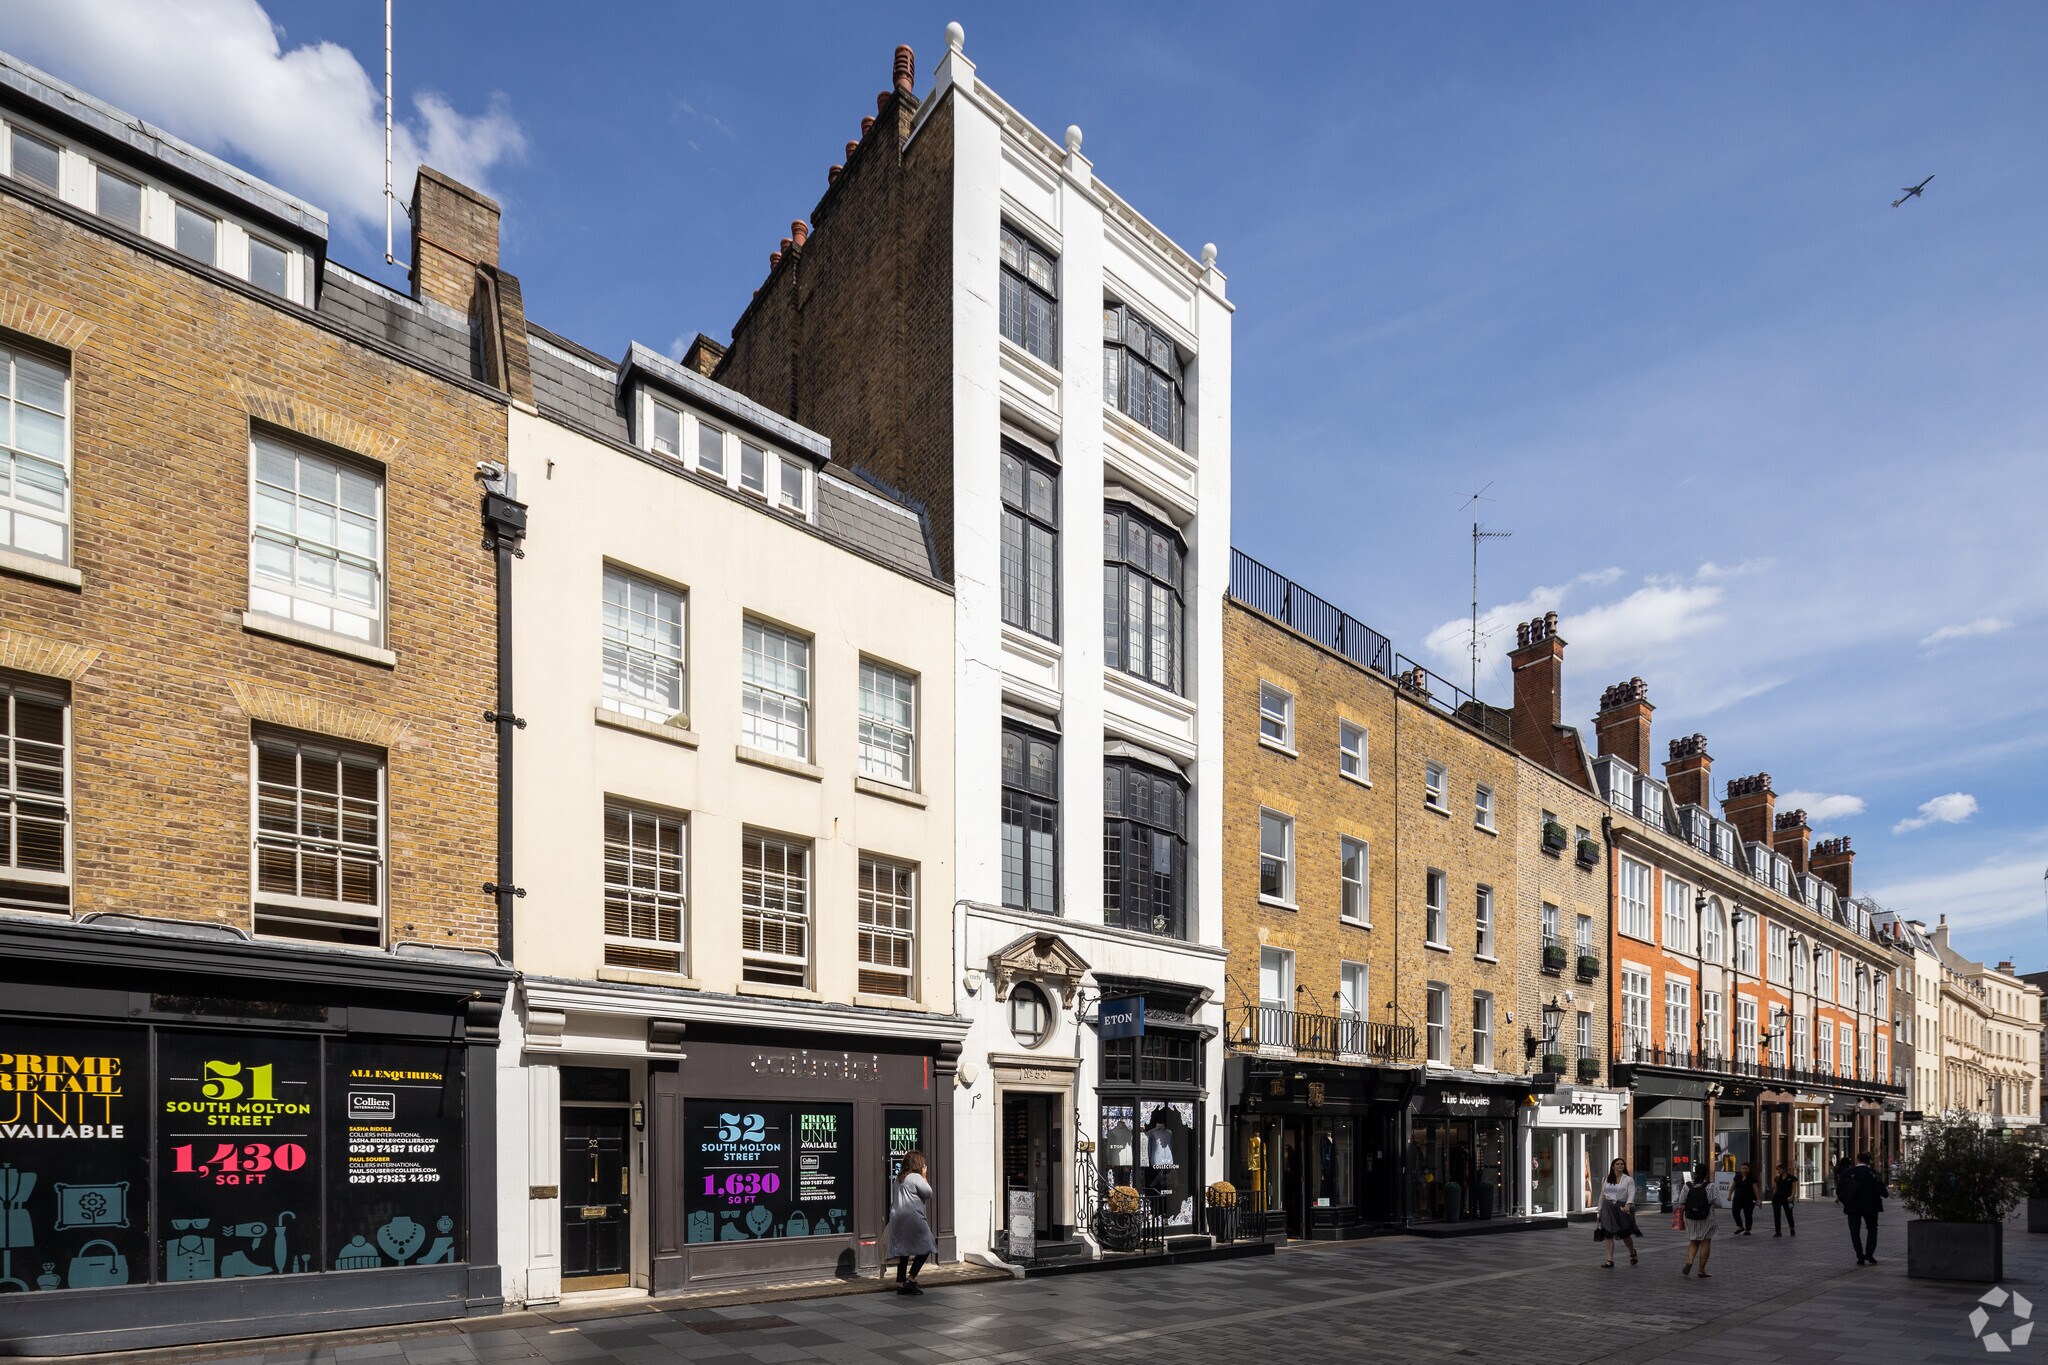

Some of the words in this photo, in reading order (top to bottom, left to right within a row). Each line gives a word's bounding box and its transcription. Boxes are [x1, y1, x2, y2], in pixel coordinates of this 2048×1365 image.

[1104, 1013, 1132, 1025] ETON
[202, 1060, 279, 1101] 51
[349, 1069, 374, 1078] ALL
[375, 1070, 443, 1081] ENQUIRIES:
[353, 1097, 390, 1106] Colliers
[1440, 1091, 1458, 1104] The
[1459, 1092, 1491, 1108] Kooples
[166, 1101, 231, 1113] SOUTH
[236, 1103, 311, 1115] MOLTON
[1559, 1103, 1603, 1116] EMPREINTE
[207, 1115, 274, 1126] STREET
[800, 1114, 837, 1123] PRIME
[0, 1124, 124, 1138] VAILABLE
[719, 1113, 766, 1143] 52
[800, 1122, 837, 1130] RETAIL
[801, 1129, 837, 1143] UNIT
[349, 1144, 375, 1153] 020
[376, 1144, 406, 1153] 7487
[407, 1144, 436, 1153] 1607
[588, 1140, 598, 1148] 52
[701, 1143, 737, 1152] SOUTH
[739, 1143, 781, 1152] MOLTON
[890, 1140, 917, 1151] UNIT
[170, 1143, 307, 1178] 1,430
[723, 1152, 761, 1161] STREET
[215, 1174, 240, 1186] SQ
[245, 1174, 266, 1185] FT
[349, 1175, 375, 1184] 020
[408, 1174, 440, 1183] 4499
[702, 1172, 780, 1198] 1,630
[728, 1196, 742, 1204] SQ
[744, 1195, 756, 1204] FT
